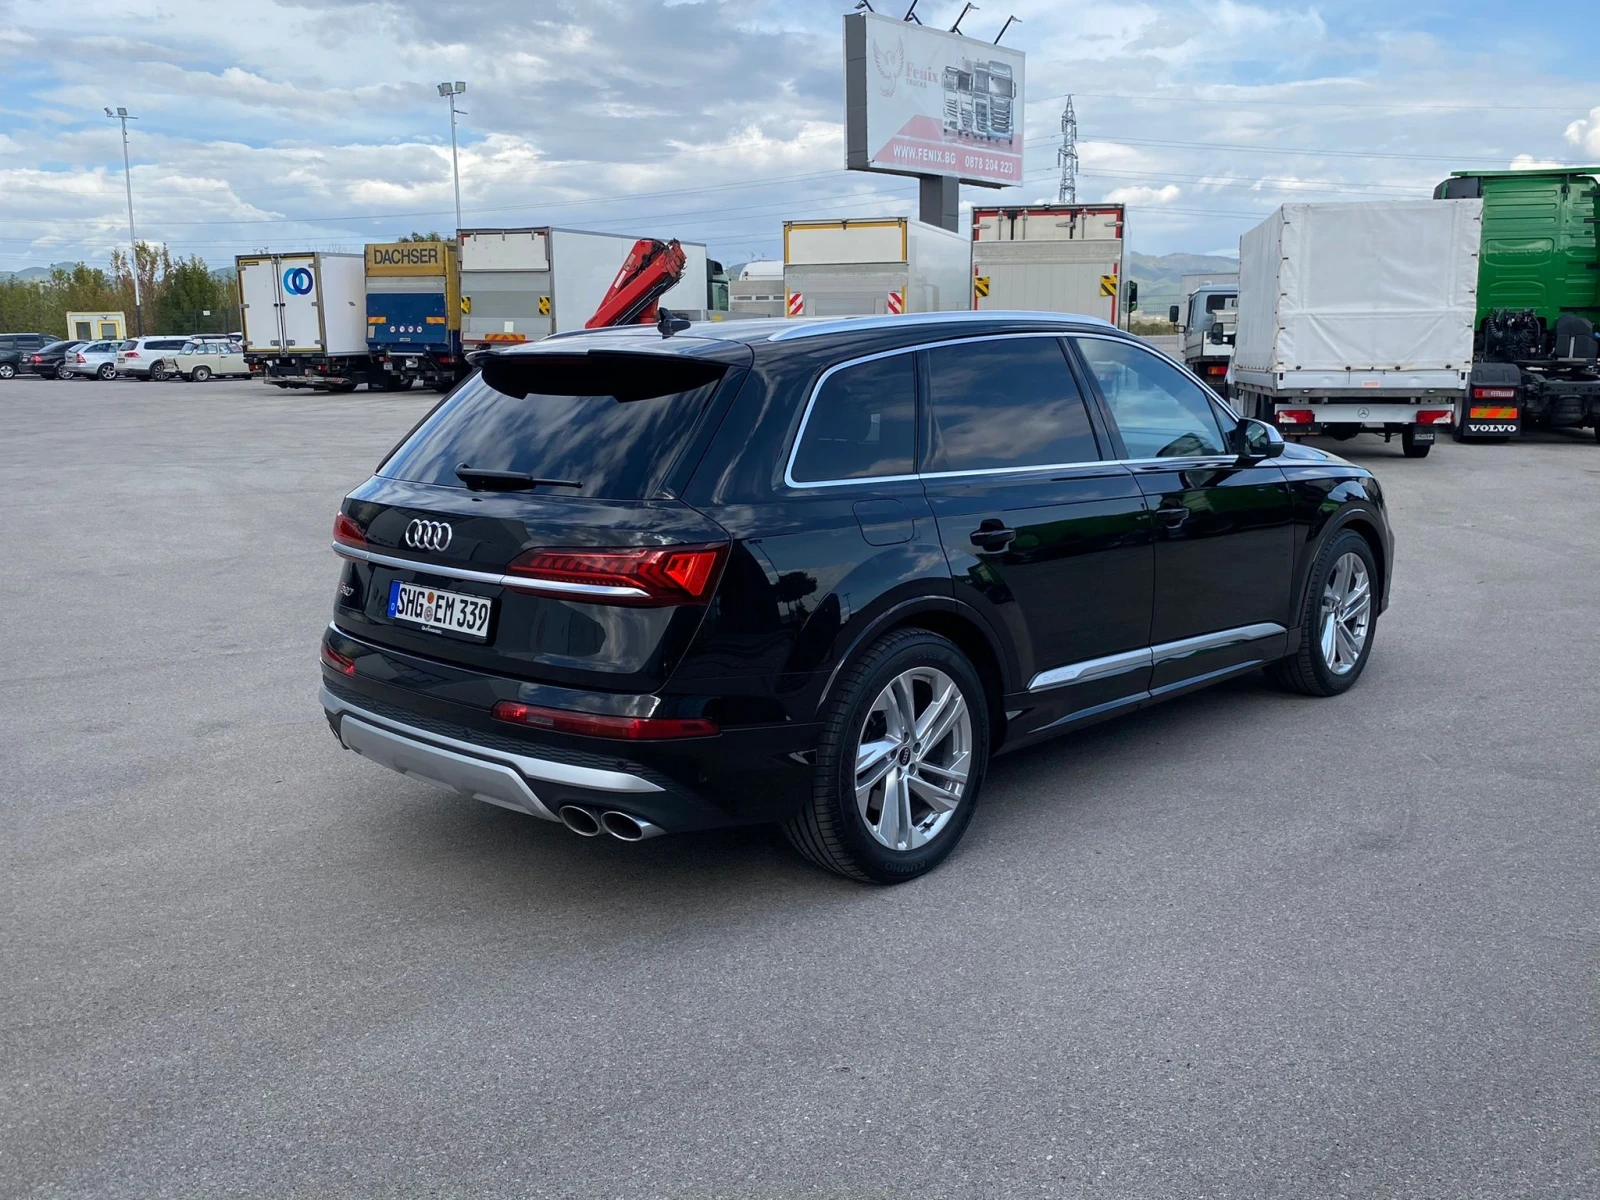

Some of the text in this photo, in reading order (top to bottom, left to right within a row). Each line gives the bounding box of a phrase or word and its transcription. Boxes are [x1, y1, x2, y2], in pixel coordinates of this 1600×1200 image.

[905, 63, 939, 84] Fenix
[893, 144, 1013, 174] WWW.FENIX.BG 0878 204 223
[373, 248, 438, 265] DACHSER
[1468, 424, 1517, 432] VOLVO
[397, 587, 425, 618] SHG
[433, 594, 455, 626] EM
[457, 599, 488, 631] 339
